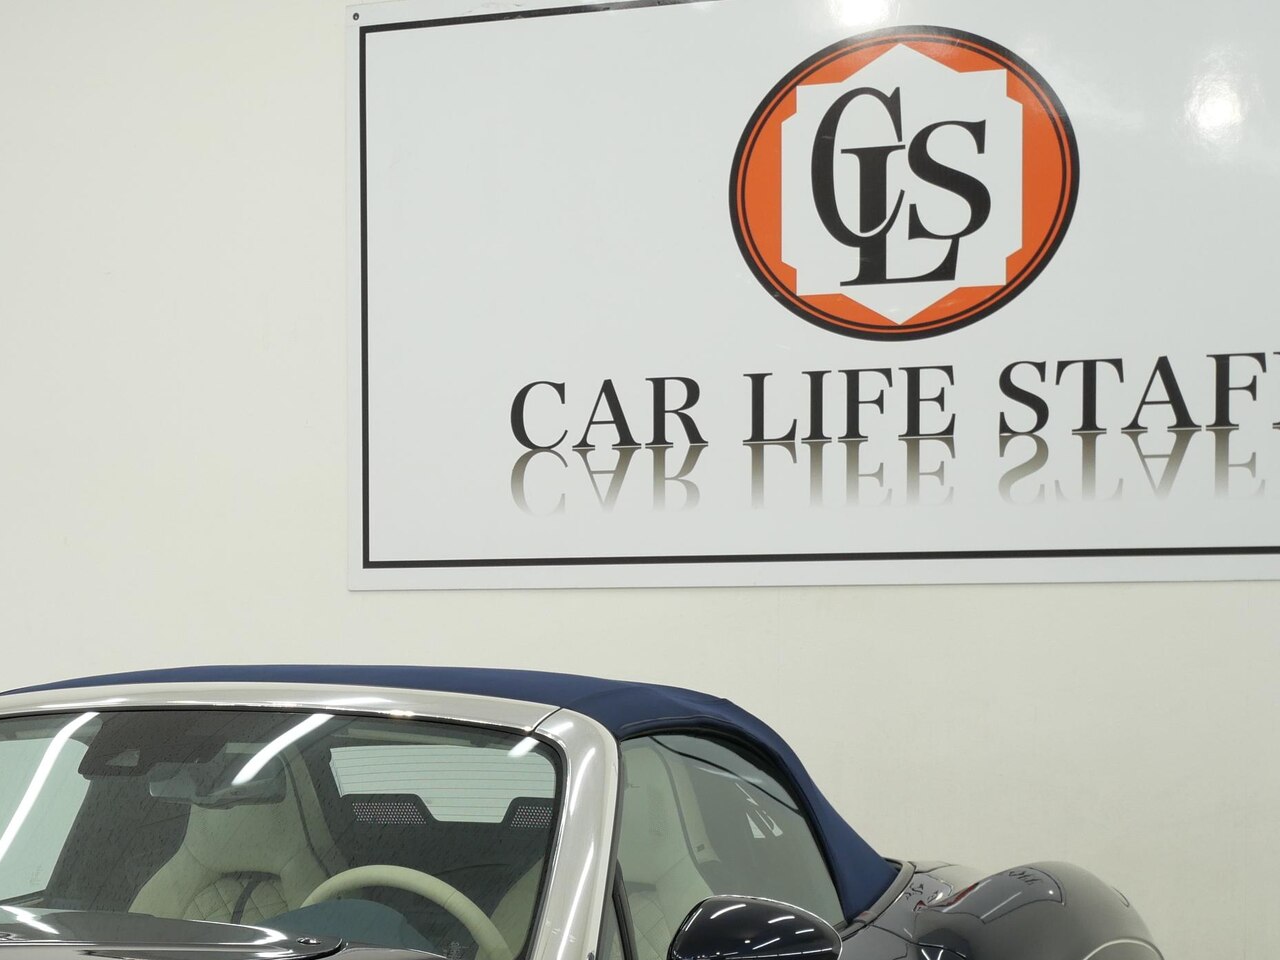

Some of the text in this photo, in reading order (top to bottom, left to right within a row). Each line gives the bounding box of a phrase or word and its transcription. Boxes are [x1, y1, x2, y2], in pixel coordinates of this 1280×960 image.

[510, 352, 1280, 450] CAR LIFE STAF
